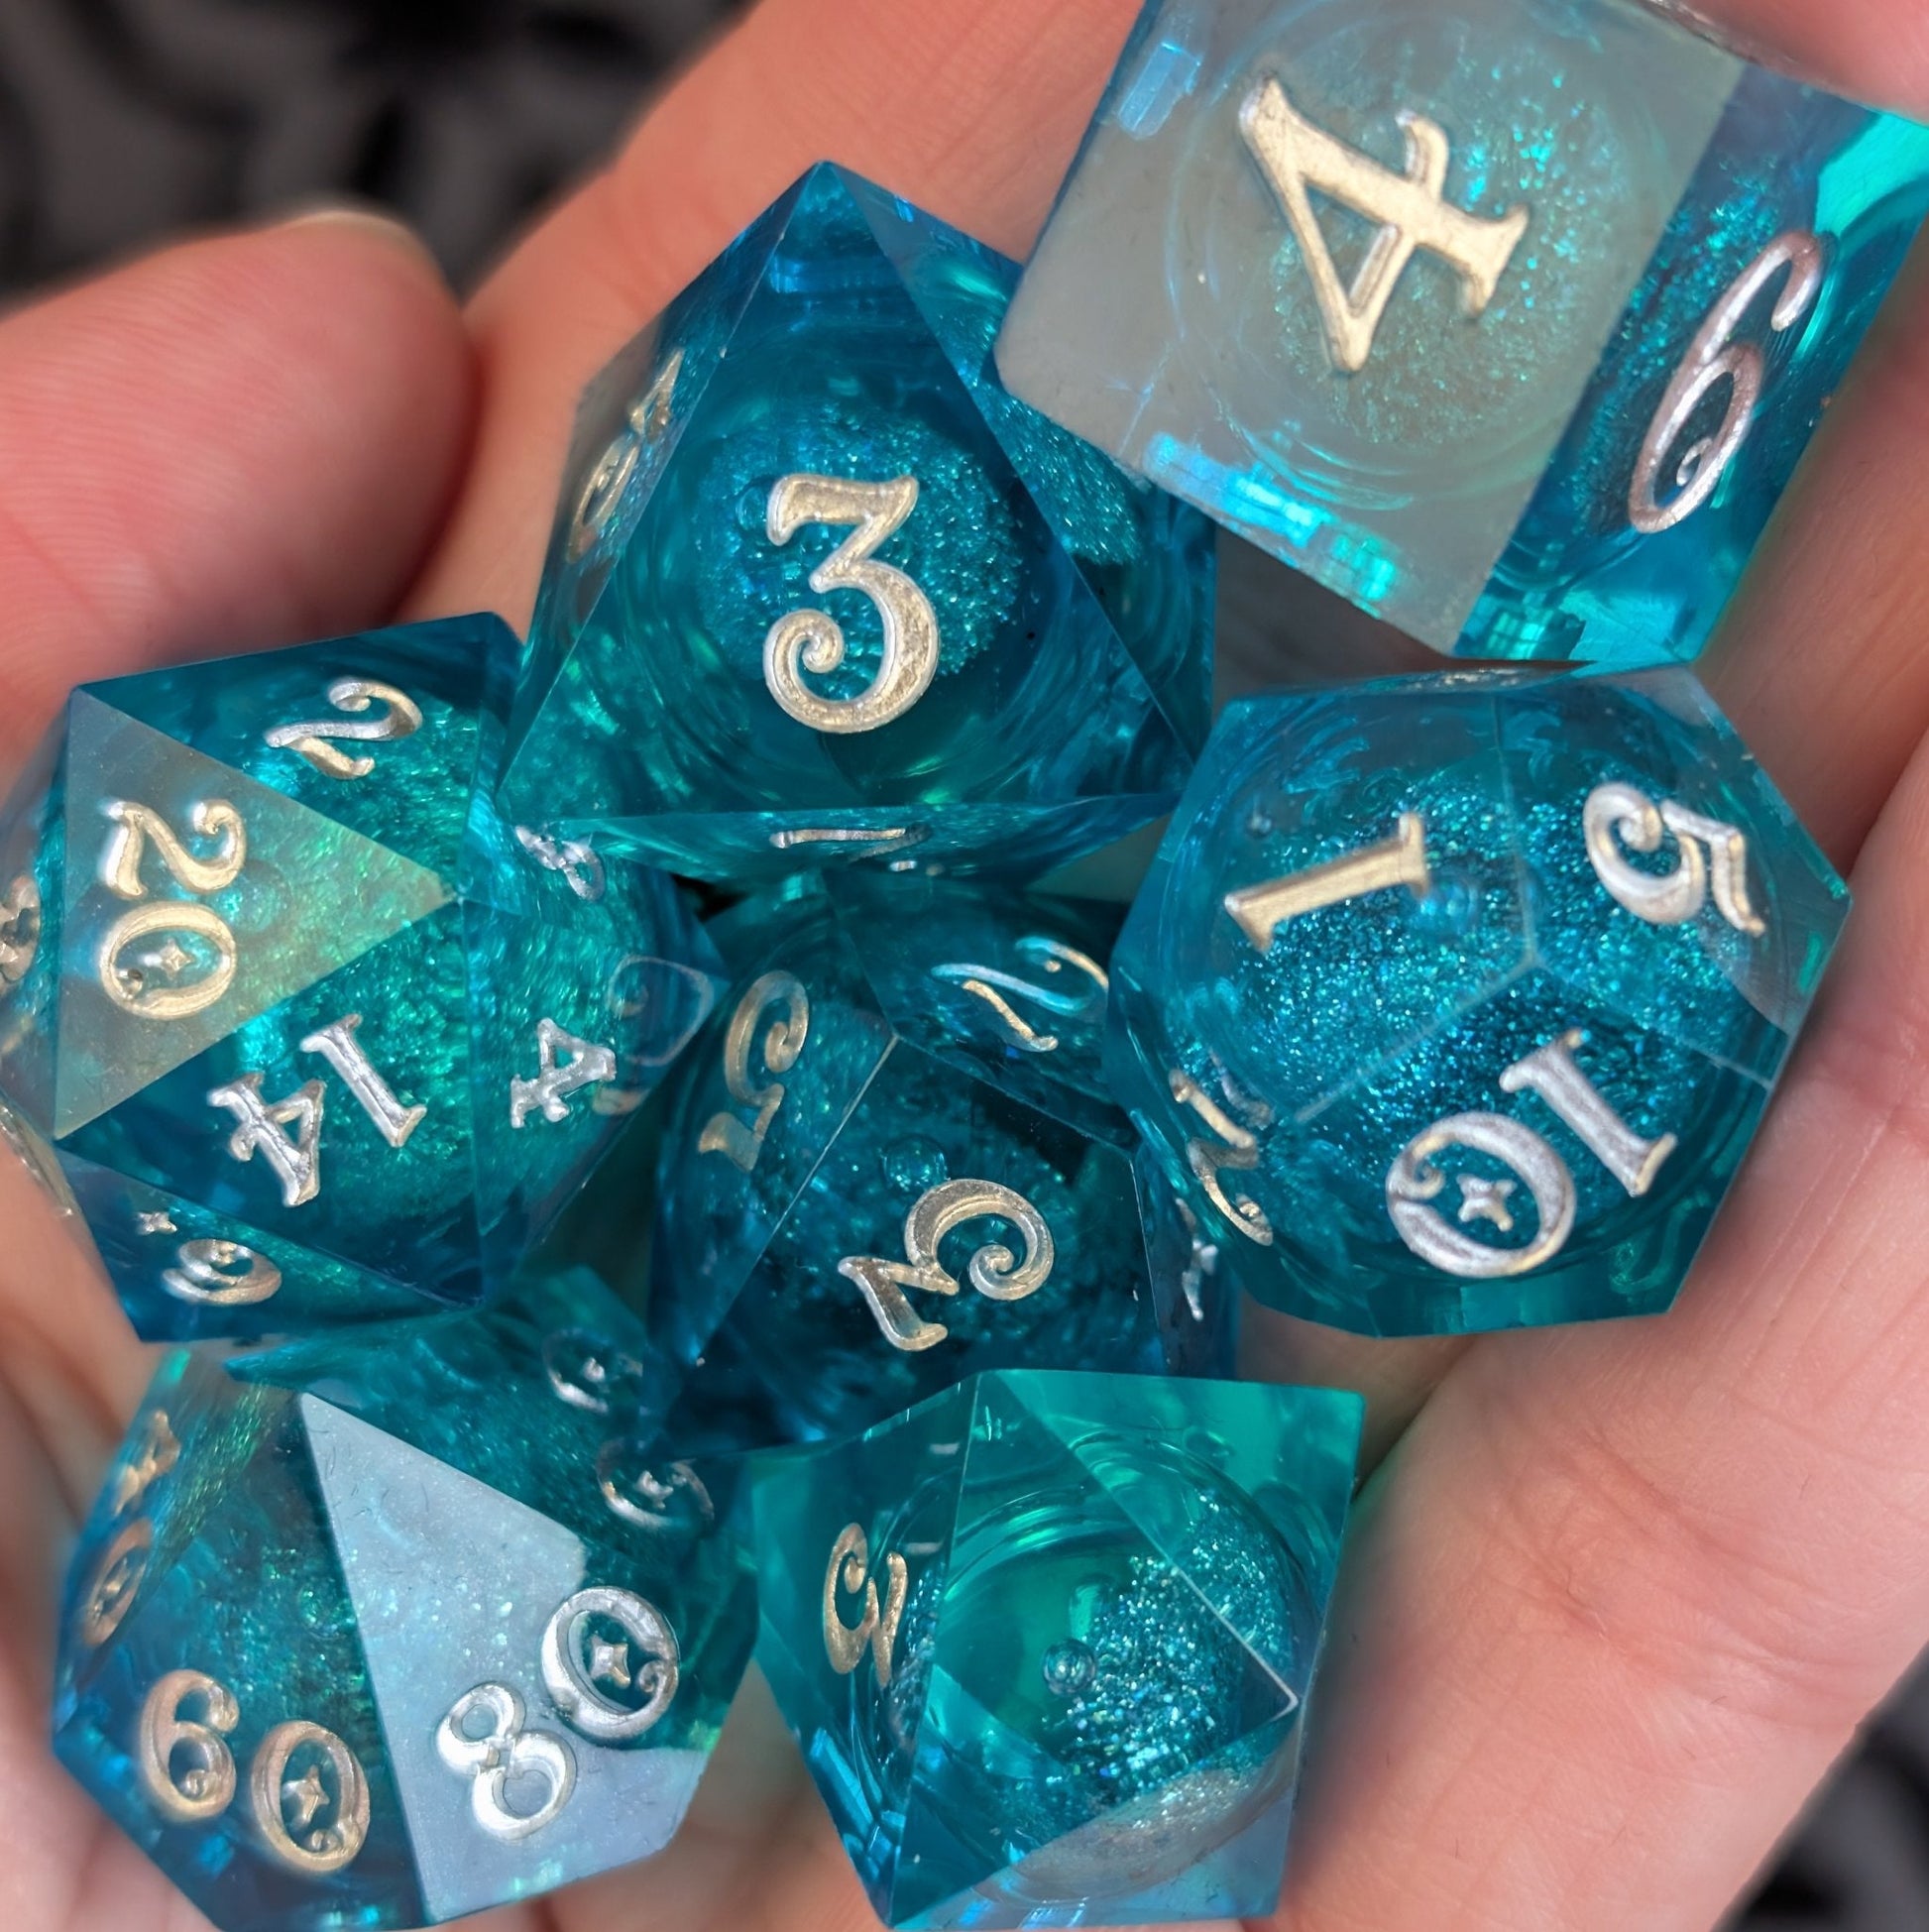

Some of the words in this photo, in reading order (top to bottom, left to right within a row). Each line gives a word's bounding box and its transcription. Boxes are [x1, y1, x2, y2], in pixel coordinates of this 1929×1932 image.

[1239, 77, 1529, 373] 4
[1629, 230, 1822, 533] 6
[763, 474, 939, 732] 3
[265, 677, 423, 779] 2
[99, 799, 246, 1020] 20
[1225, 812, 1429, 953] 1
[1583, 782, 1764, 935] 5
[207, 1013, 426, 1207] 14
[510, 1018, 617, 1128] 4
[698, 969, 810, 1171] 5
[1388, 1029, 1677, 1279] 10
[838, 1178, 1054, 1351] 3
[823, 1522, 909, 1689] 3
[140, 1669, 372, 1873] 60
[436, 1586, 681, 1841] 80
